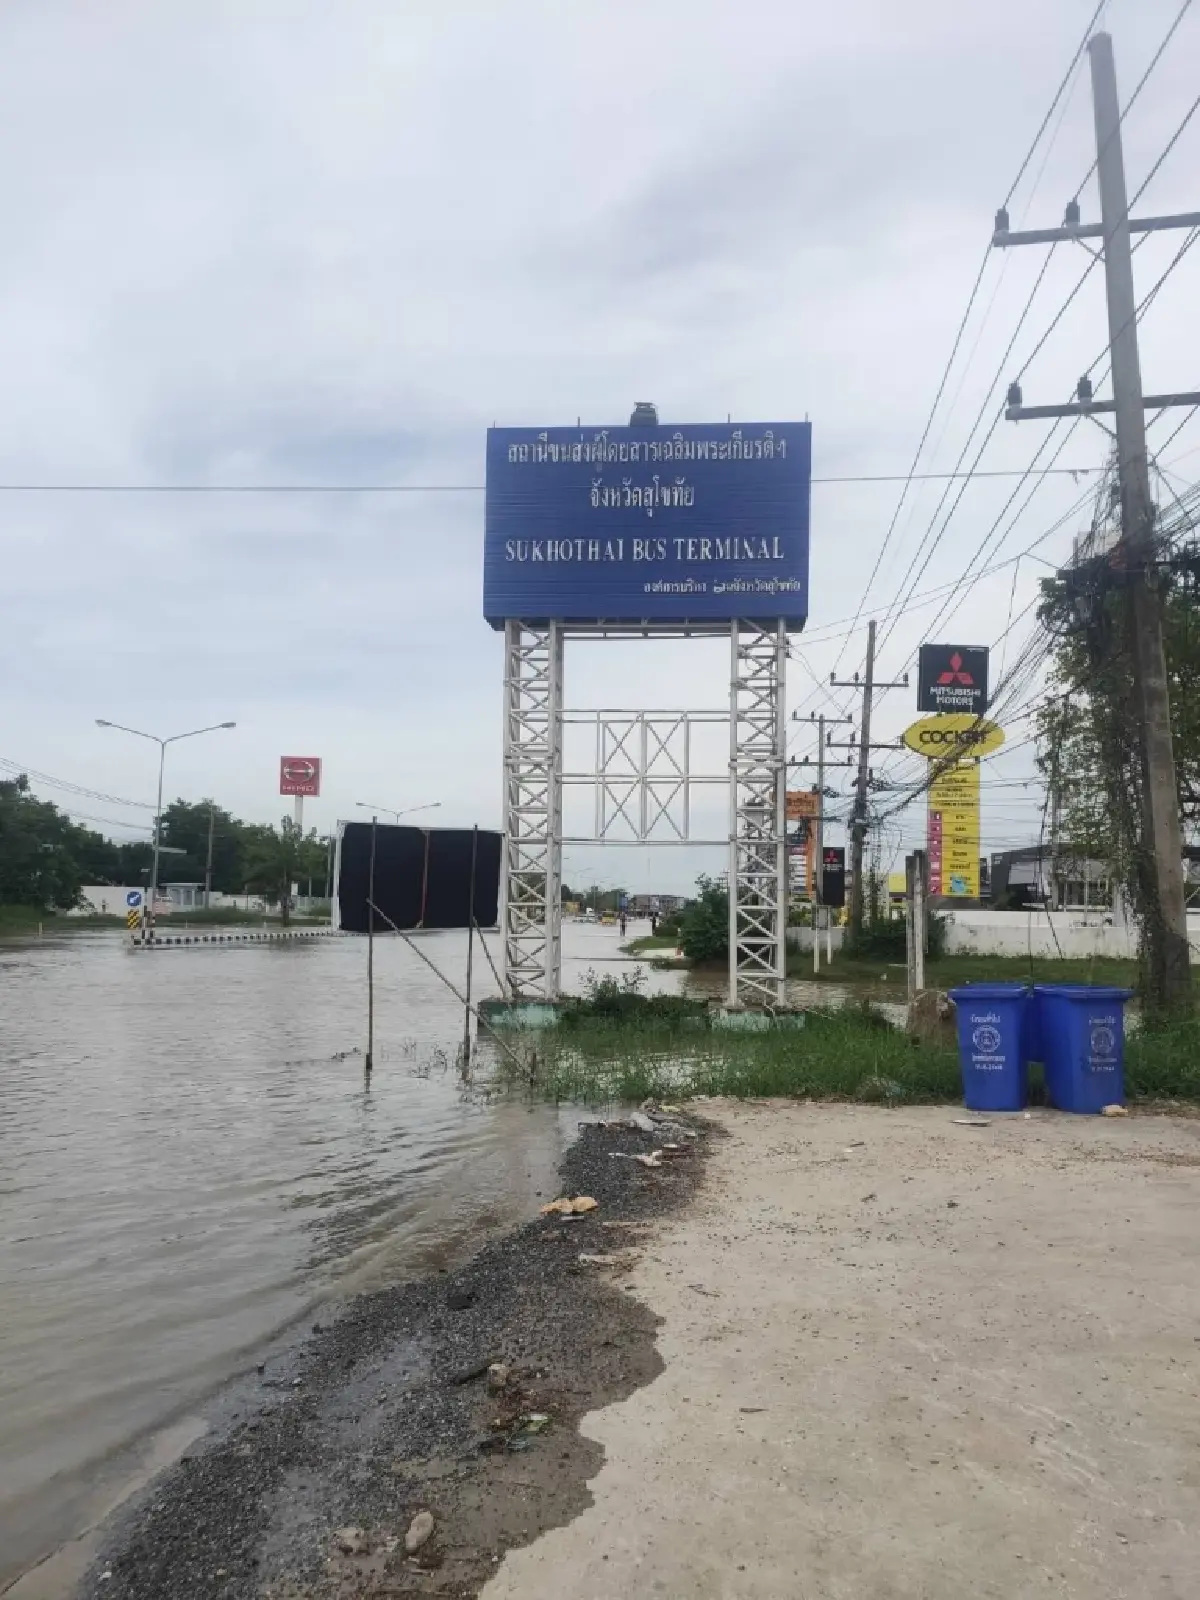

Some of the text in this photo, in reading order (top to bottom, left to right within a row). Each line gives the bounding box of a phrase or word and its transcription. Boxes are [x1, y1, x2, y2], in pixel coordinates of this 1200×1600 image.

[591, 476, 695, 517] จังหวัดสุโขทัย
[505, 536, 785, 562] SUKHOTHAI BUS TERMINAL
[930, 686, 981, 697] MITSUBISHI
[936, 696, 973, 705] MOTORS
